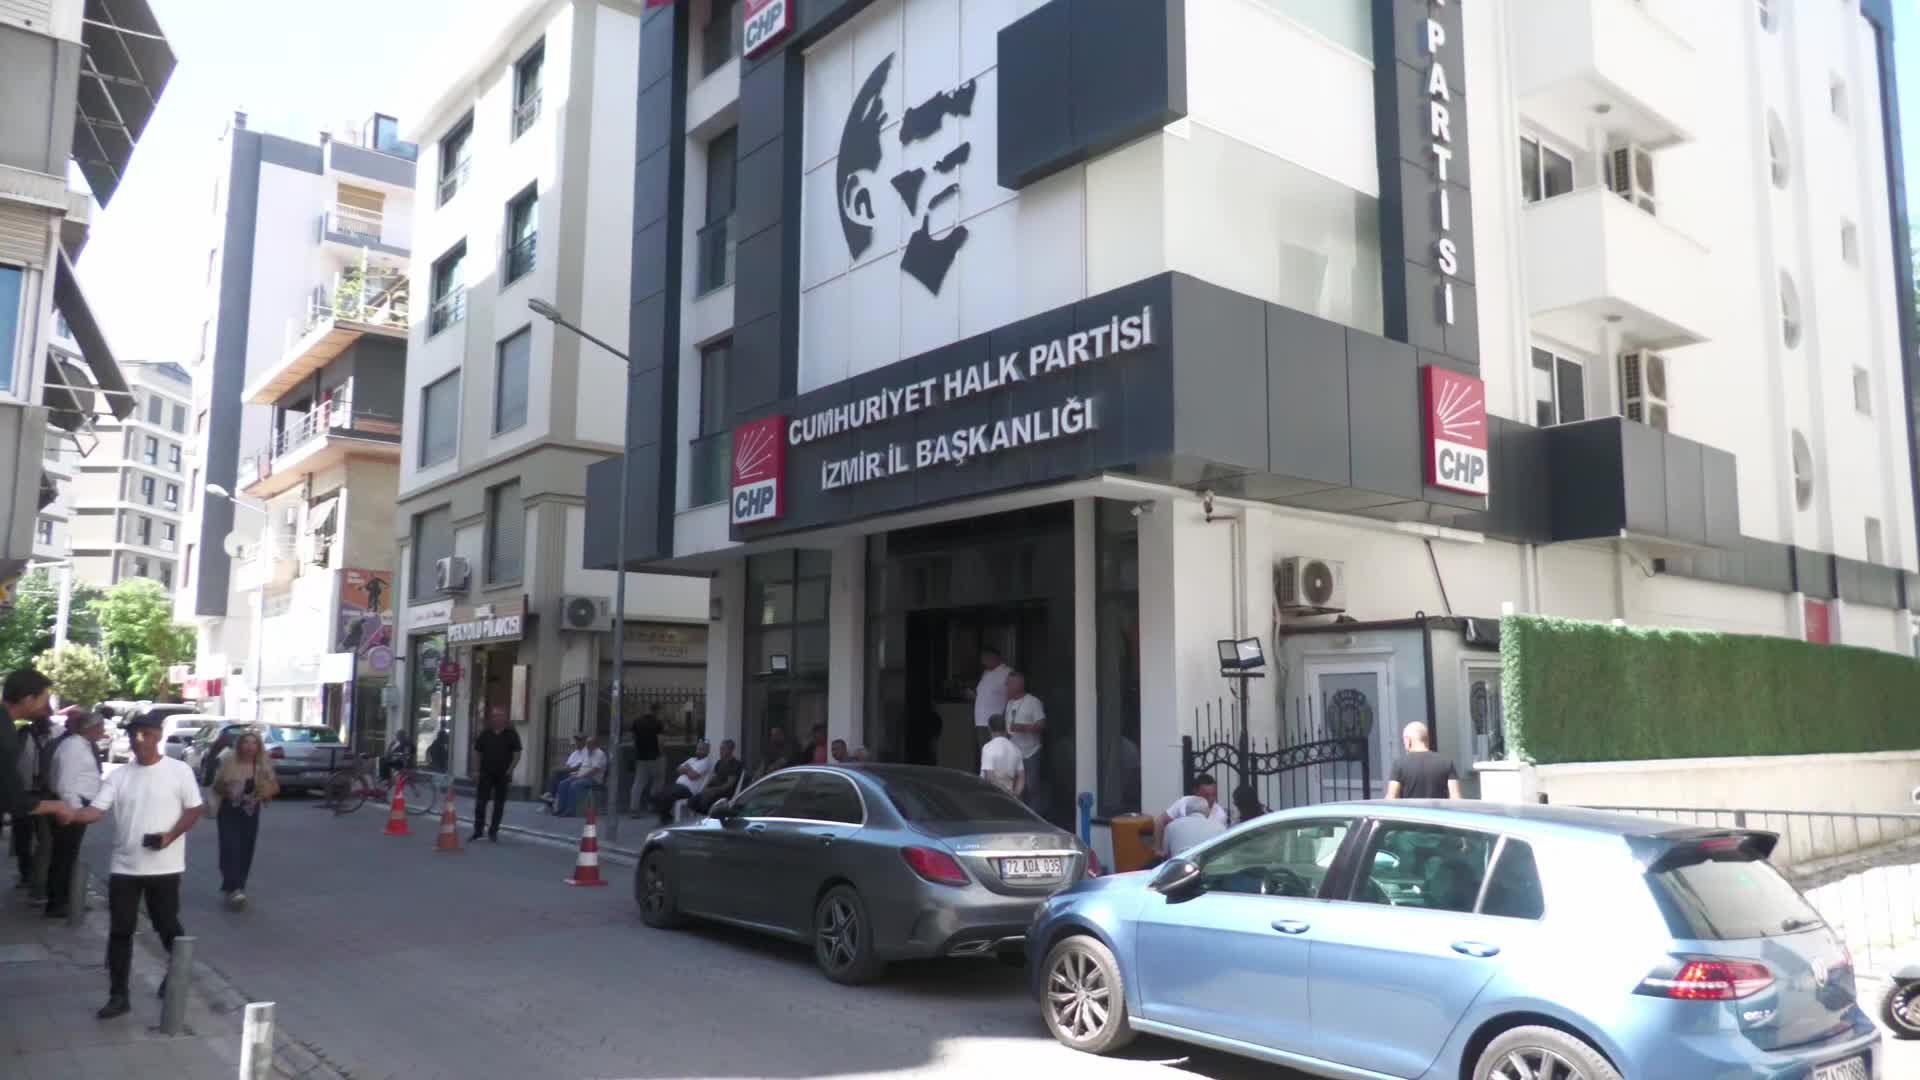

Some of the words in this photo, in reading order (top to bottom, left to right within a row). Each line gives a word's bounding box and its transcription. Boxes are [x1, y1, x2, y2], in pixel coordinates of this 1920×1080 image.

[745, 1, 782, 48] CHP
[789, 377, 937, 446] CUMHURİYET
[943, 352, 1021, 401] HALK
[1030, 305, 1153, 377] PARTİSİ
[821, 450, 881, 490] İZMİR
[888, 443, 910, 475] İL
[916, 397, 1094, 467] BAŞKANLIĞI
[1439, 448, 1484, 484] CHP
[735, 485, 774, 518] CHP
